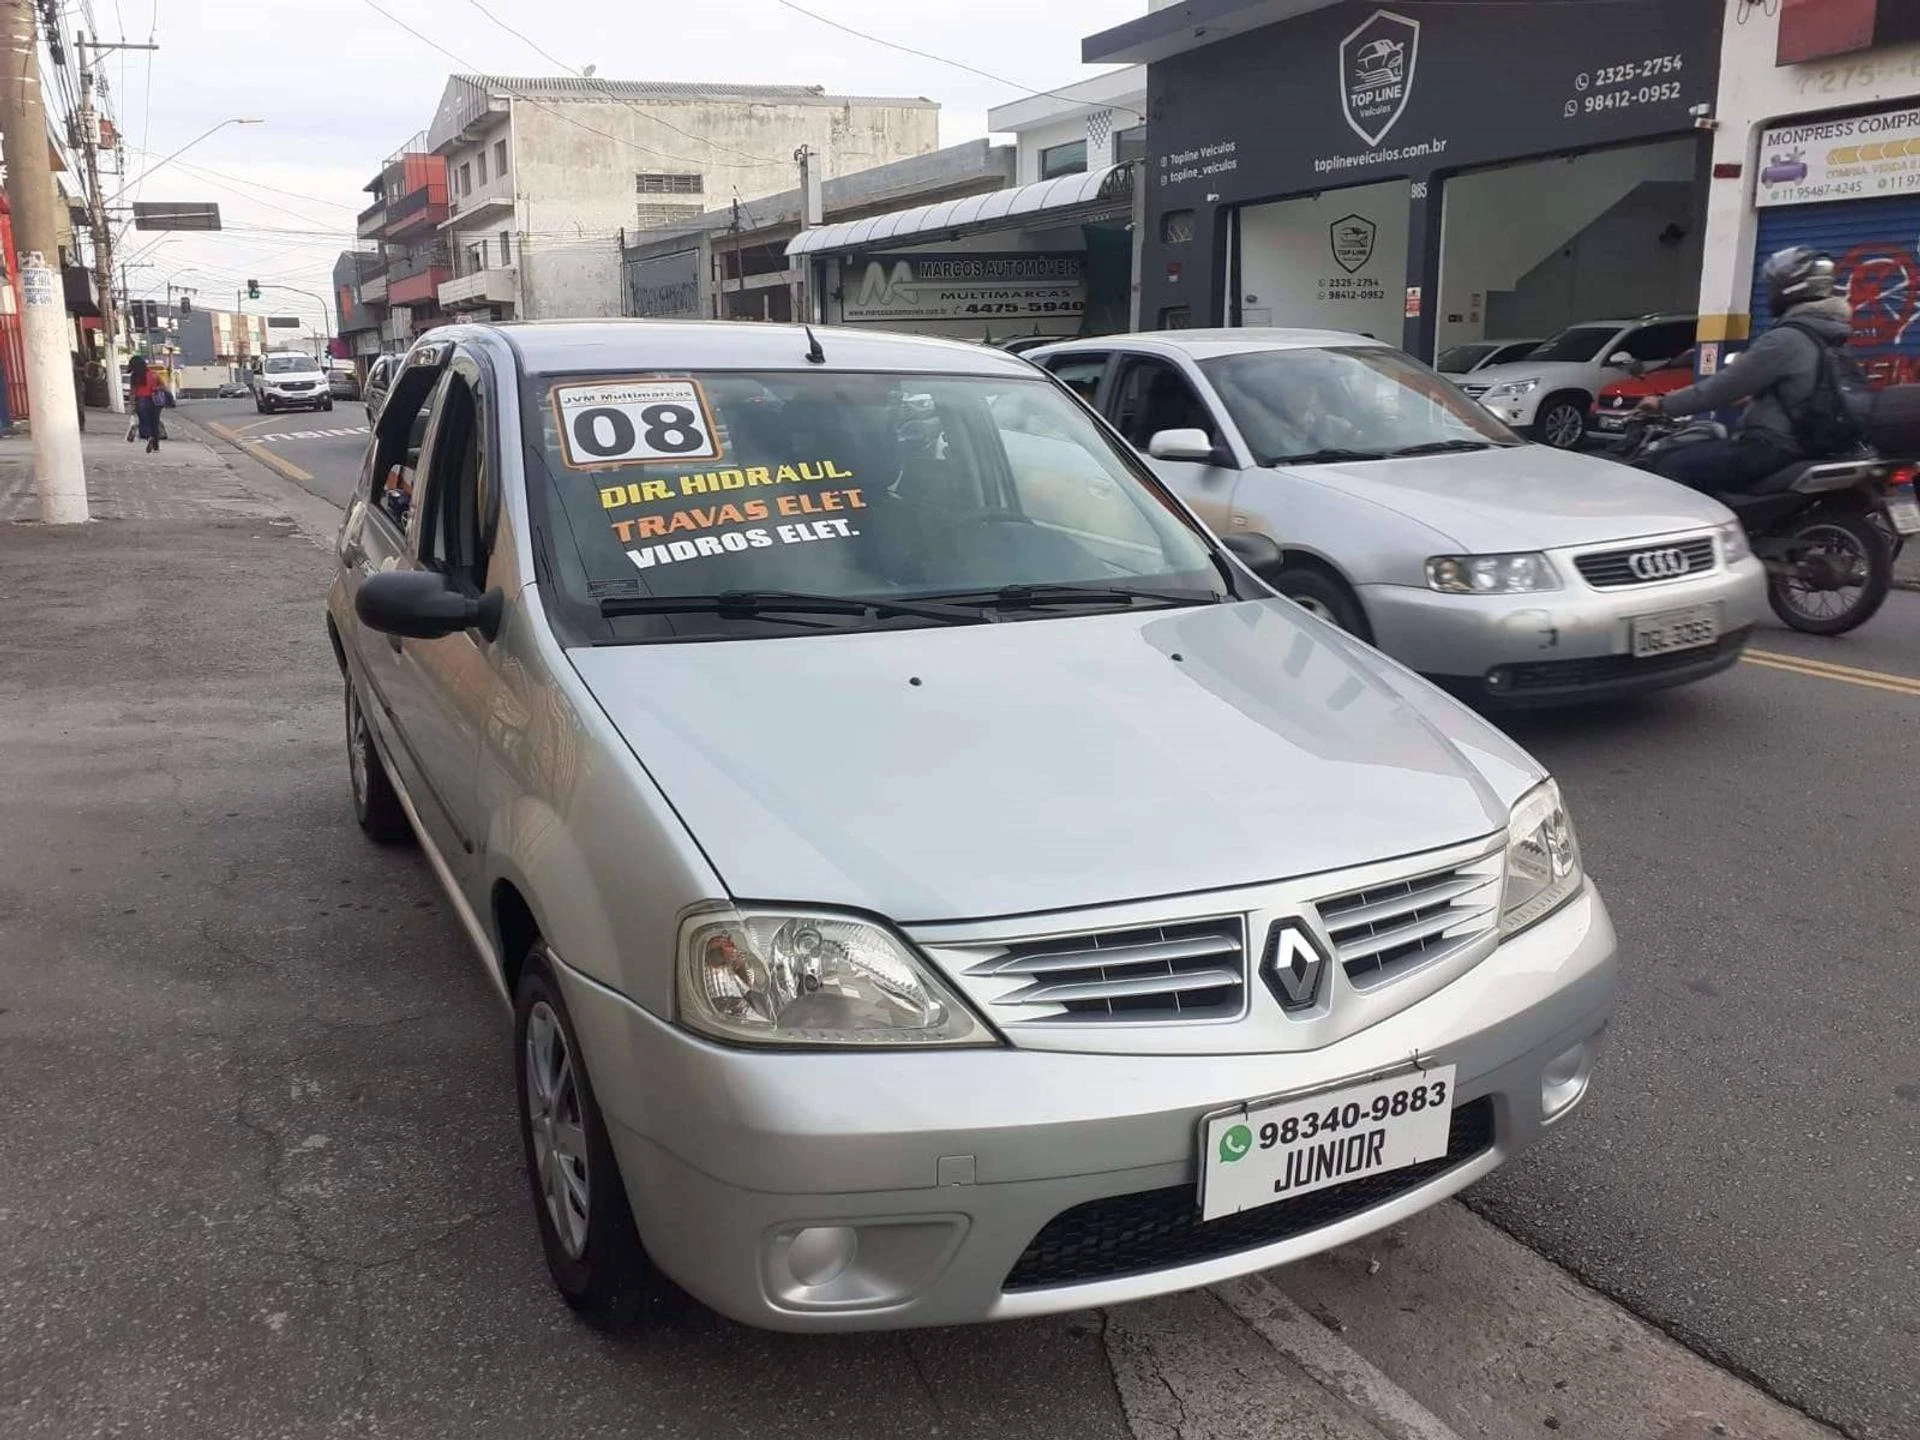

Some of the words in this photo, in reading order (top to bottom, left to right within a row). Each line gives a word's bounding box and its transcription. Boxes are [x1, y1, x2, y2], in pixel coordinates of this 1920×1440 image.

[1596, 54, 1682, 86] 2325-2754
[1351, 91, 1373, 107] TOP
[1375, 84, 1402, 102] LINE
[1584, 81, 1681, 112] 98412-0952
[1767, 122, 1854, 147] MONPRESS
[1858, 112, 1920, 134] COMPR
[1170, 150, 1199, 166] Topline
[1315, 138, 1447, 172] toplineveiculos.com.br
[940, 289, 1072, 300] MULTIMARCAS
[965, 300, 1084, 314] 4475-5940
[563, 394, 596, 404] JVM
[600, 390, 692, 402] Multimarcas
[573, 403, 704, 457] 08
[600, 479, 676, 509] DIR.
[680, 460, 853, 496] HIDRAUL.
[611, 499, 770, 543] TRAVAS
[625, 527, 773, 570] VIDROS
[776, 517, 861, 546] ELET.
[1258, 1080, 1447, 1150] 98340-9883
[1273, 1127, 1386, 1193] JUNIOR
